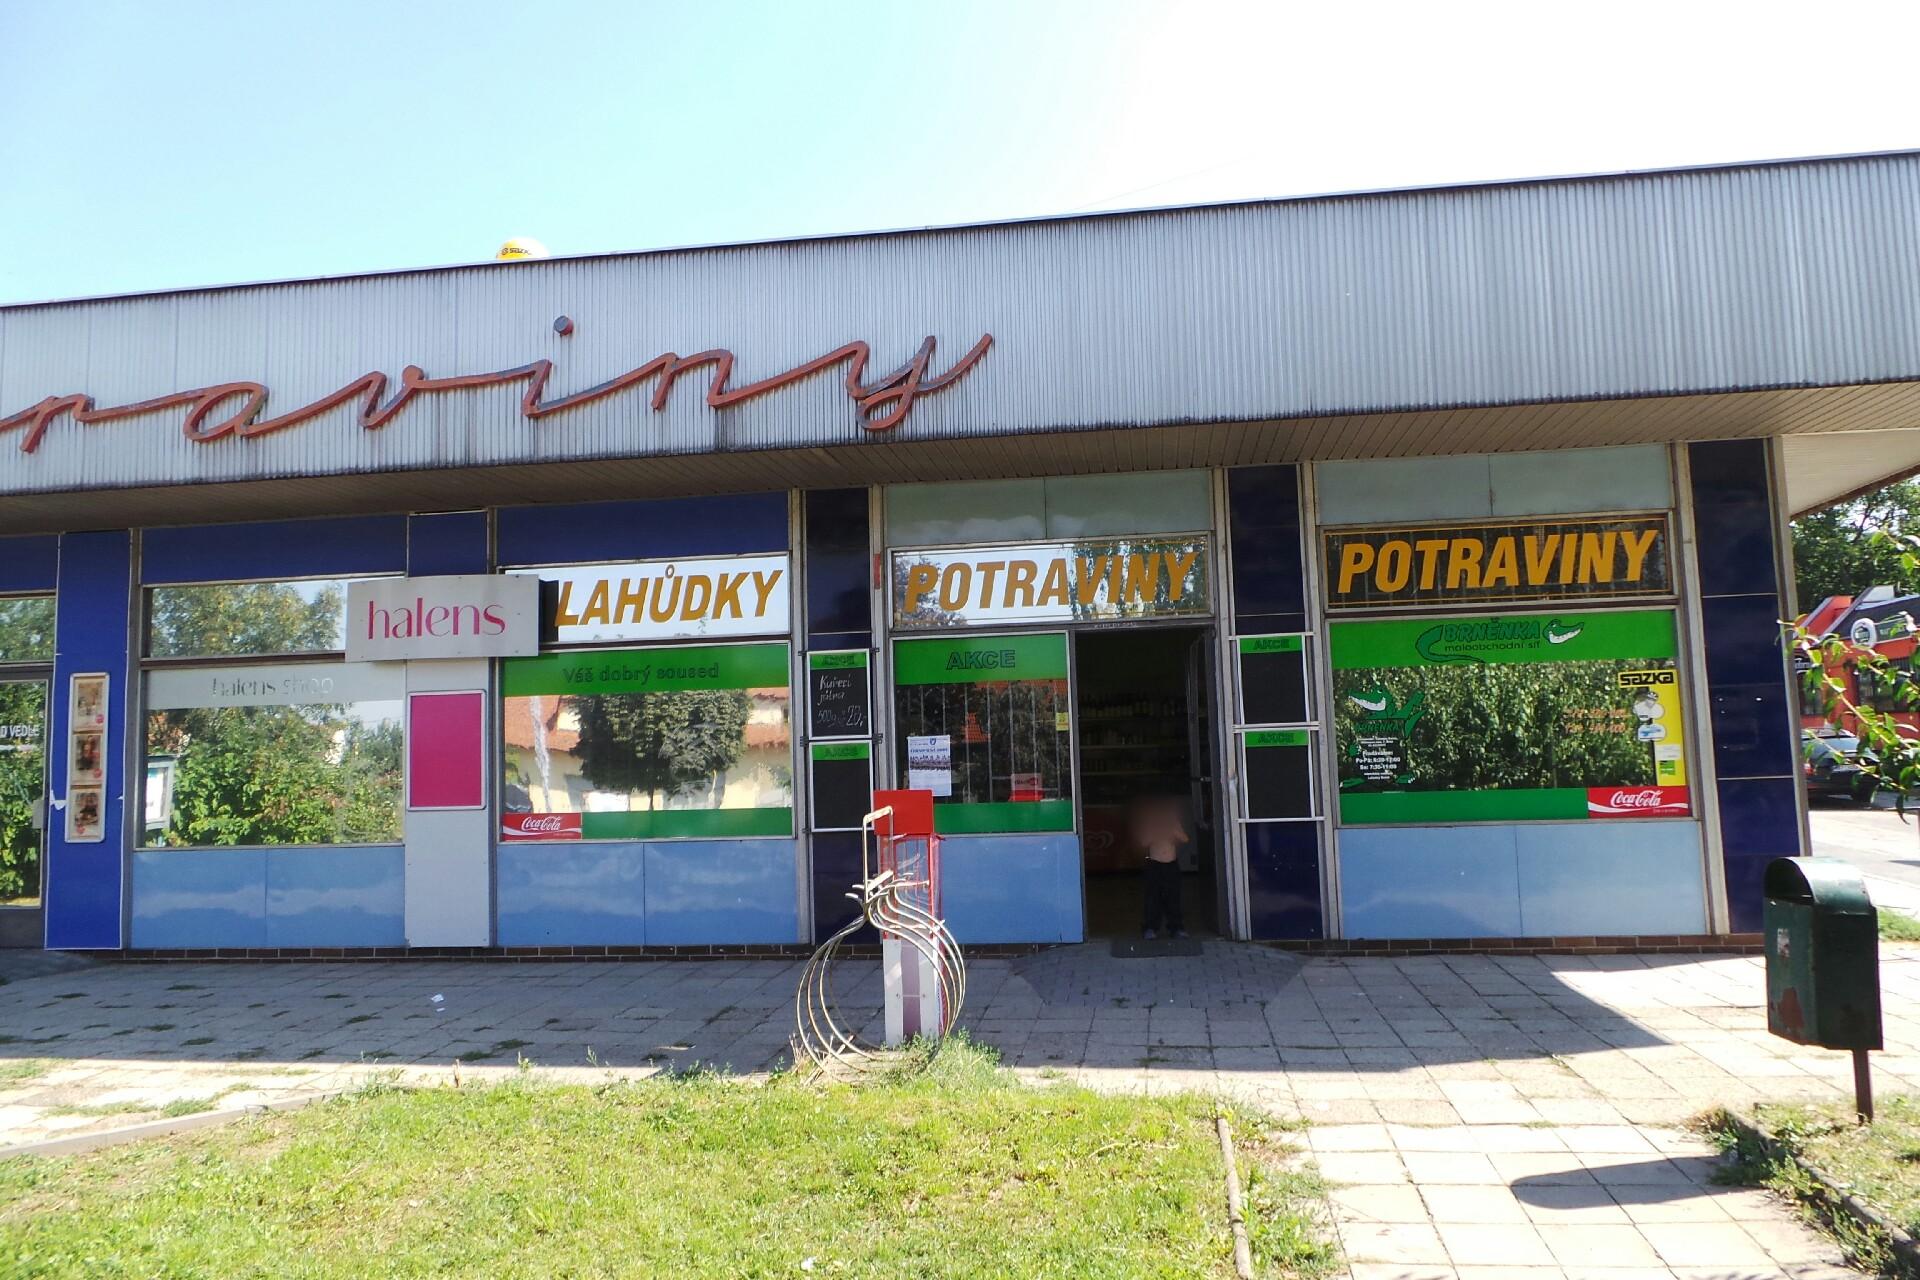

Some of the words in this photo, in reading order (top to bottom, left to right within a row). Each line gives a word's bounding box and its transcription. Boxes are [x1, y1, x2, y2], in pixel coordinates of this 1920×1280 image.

[1337, 529, 1659, 595] POTRAVINY
[903, 552, 1198, 613] POTRAVINY
[554, 563, 784, 628] LAHŮDKY
[367, 597, 507, 641] halens
[1444, 617, 1541, 642] BRNĚNKA
[946, 649, 1016, 670] AKCE
[562, 666, 594, 684] Váš
[600, 664, 651, 686] dobrý
[656, 662, 720, 681] soused
[212, 678, 277, 697] halens
[10, 724, 40, 737] VEDLE
